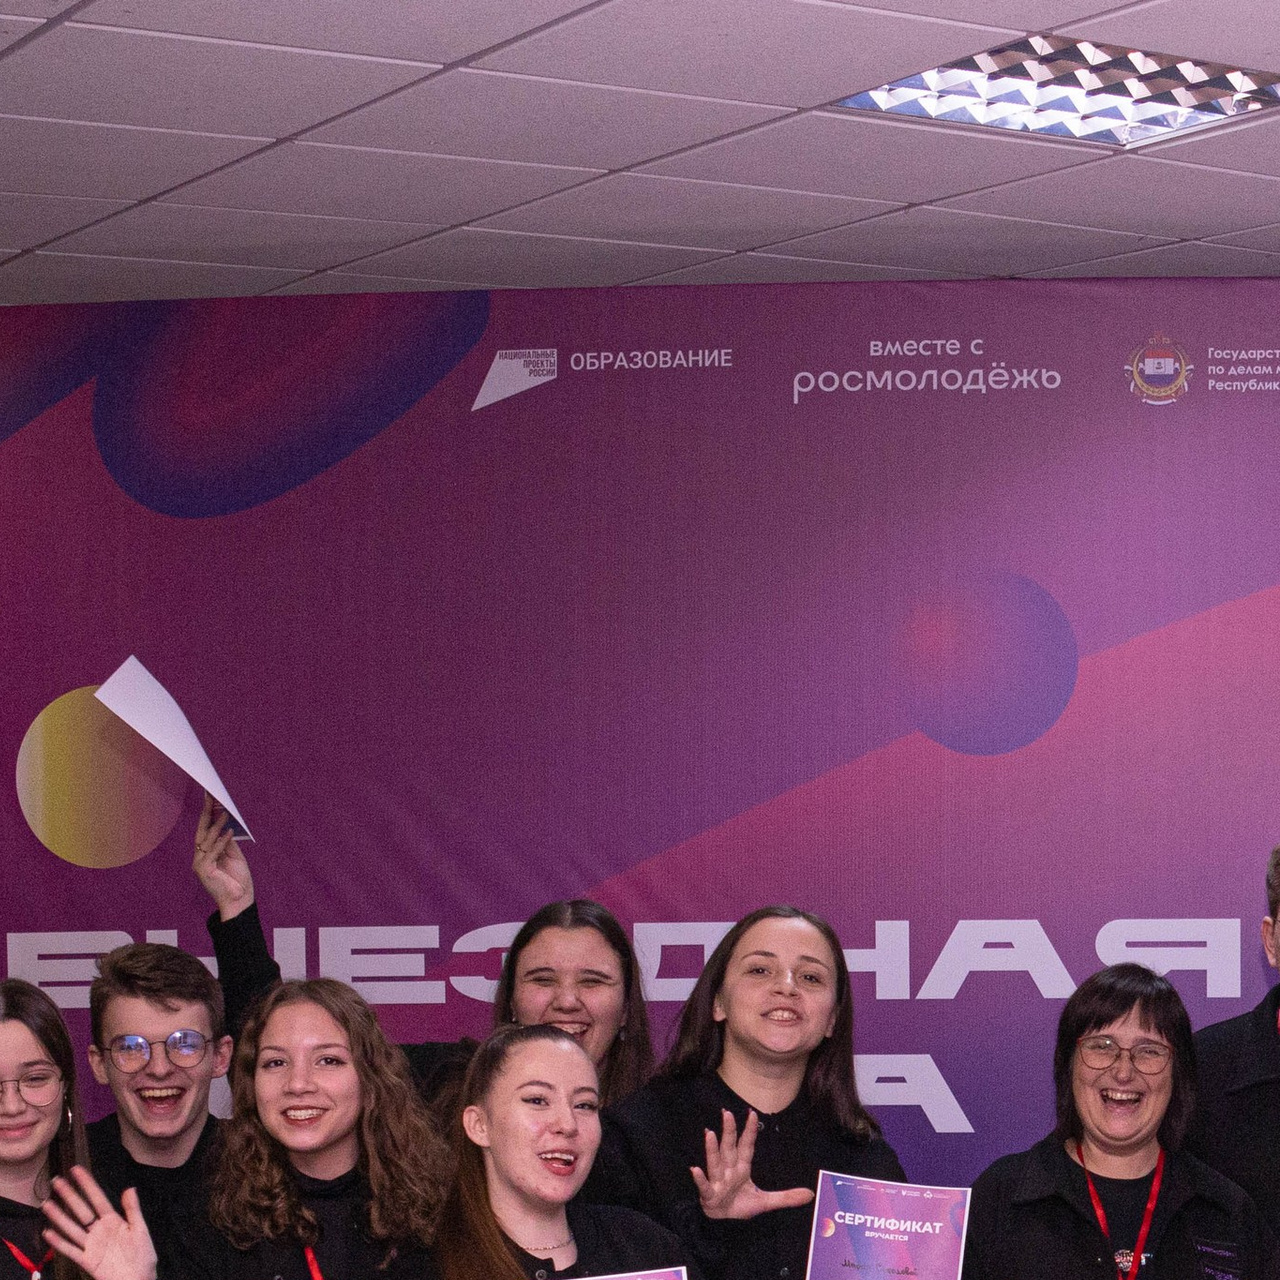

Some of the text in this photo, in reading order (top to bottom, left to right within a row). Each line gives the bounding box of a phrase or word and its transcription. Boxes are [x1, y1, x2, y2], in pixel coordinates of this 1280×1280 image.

[870, 339, 984, 355] вместе с
[499, 351, 556, 360] НАЦИОНАЛЬНЫЕ
[570, 350, 733, 370] ОБРАЗОВАНИЕ
[523, 359, 556, 369] ПРОЕКТЫ
[1208, 365, 1225, 375] по
[1228, 364, 1273, 376] делам
[528, 368, 556, 377] РОССИИ
[793, 362, 1061, 404] росмолодёжь
[834, 1211, 943, 1234] СЕРТИФИКАТ
[865, 1231, 908, 1241] ВРУЧАЕТСЯ
